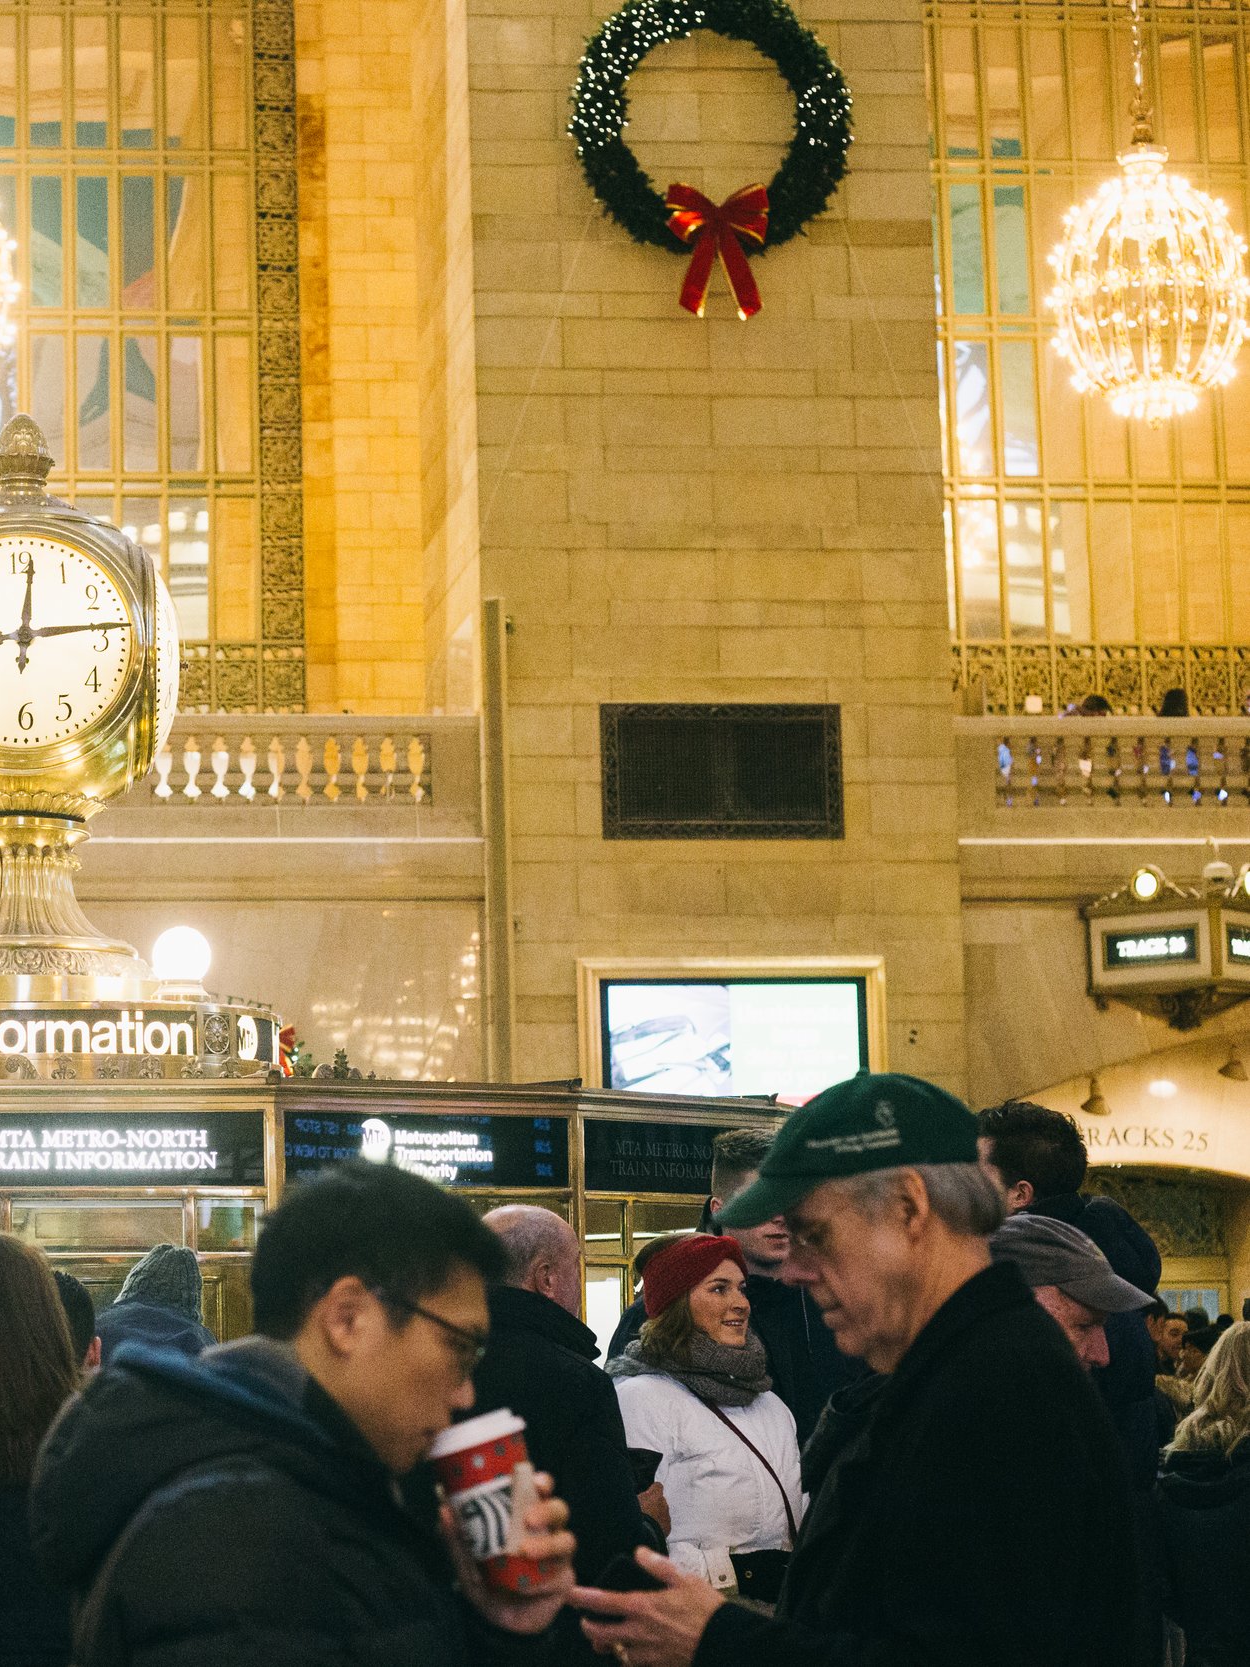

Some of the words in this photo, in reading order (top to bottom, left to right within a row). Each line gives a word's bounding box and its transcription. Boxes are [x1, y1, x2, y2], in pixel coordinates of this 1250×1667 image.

[9, 551, 33, 575] 12
[58, 560, 66, 584] 1
[85, 584, 100, 610] 2
[92, 627, 110, 652] 3
[84, 665, 101, 693] 4
[18, 701, 34, 731] 6
[56, 694, 73, 722] 5
[41, 1129, 208, 1148] METRO-NORTH
[395, 1130, 479, 1148] Metropolitan
[615, 1140, 643, 1156] MTA
[1080, 1126, 1174, 1150] RACKS
[1183, 1130, 1209, 1152] 25
[54, 1150, 218, 1170] INFORMATION
[395, 1146, 494, 1165] Transportation
[610, 1160, 650, 1176] TRAIN
